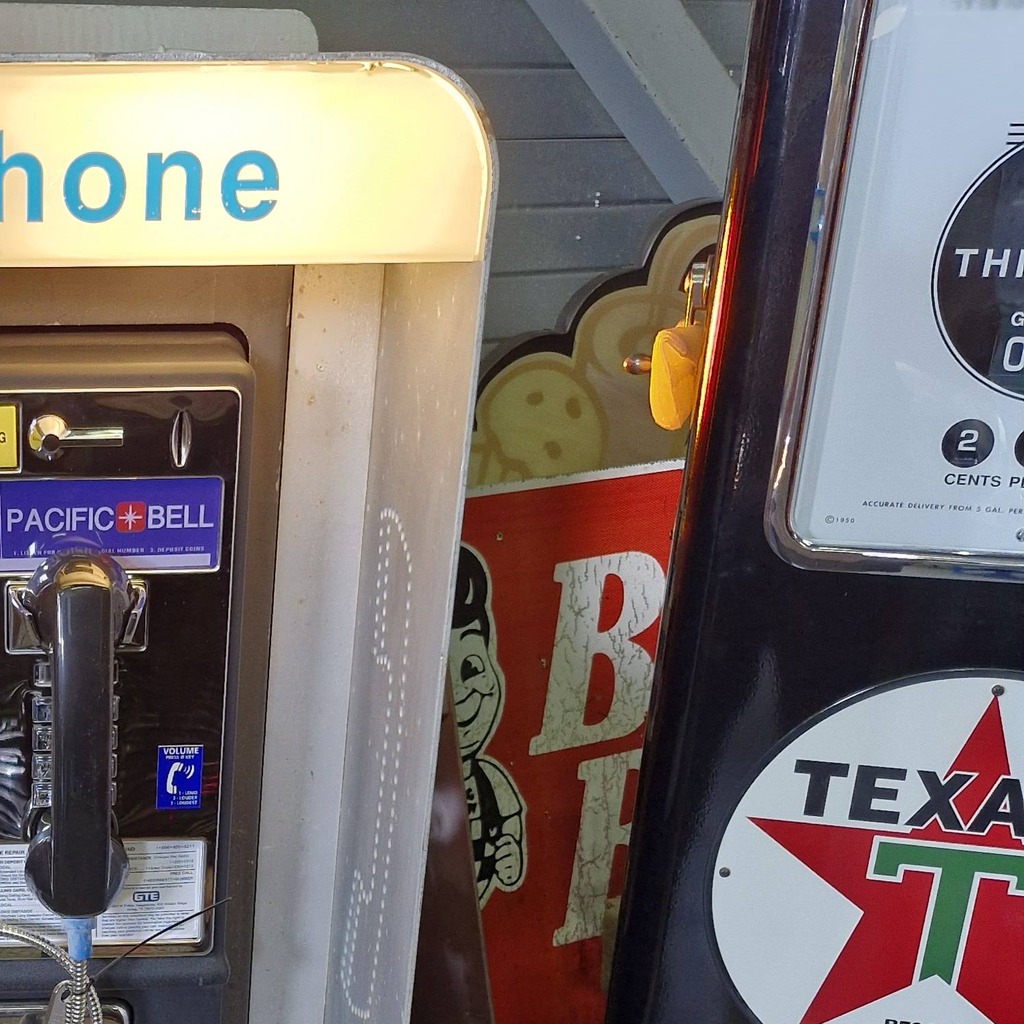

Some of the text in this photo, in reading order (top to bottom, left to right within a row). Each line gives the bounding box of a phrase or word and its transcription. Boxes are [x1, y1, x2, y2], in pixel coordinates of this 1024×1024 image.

[957, 429, 979, 452] 2
[944, 473, 1002, 488] CENTS
[862, 500, 904, 509] ACCURATE
[908, 502, 945, 510] DELIVERY
[948, 504, 972, 512] FROM
[6, 504, 214, 532] PACIFIC BELL
[163, 747, 199, 755] VOLUME
[794, 759, 1024, 838] TEXA
[135, 891, 159, 902] GTE
